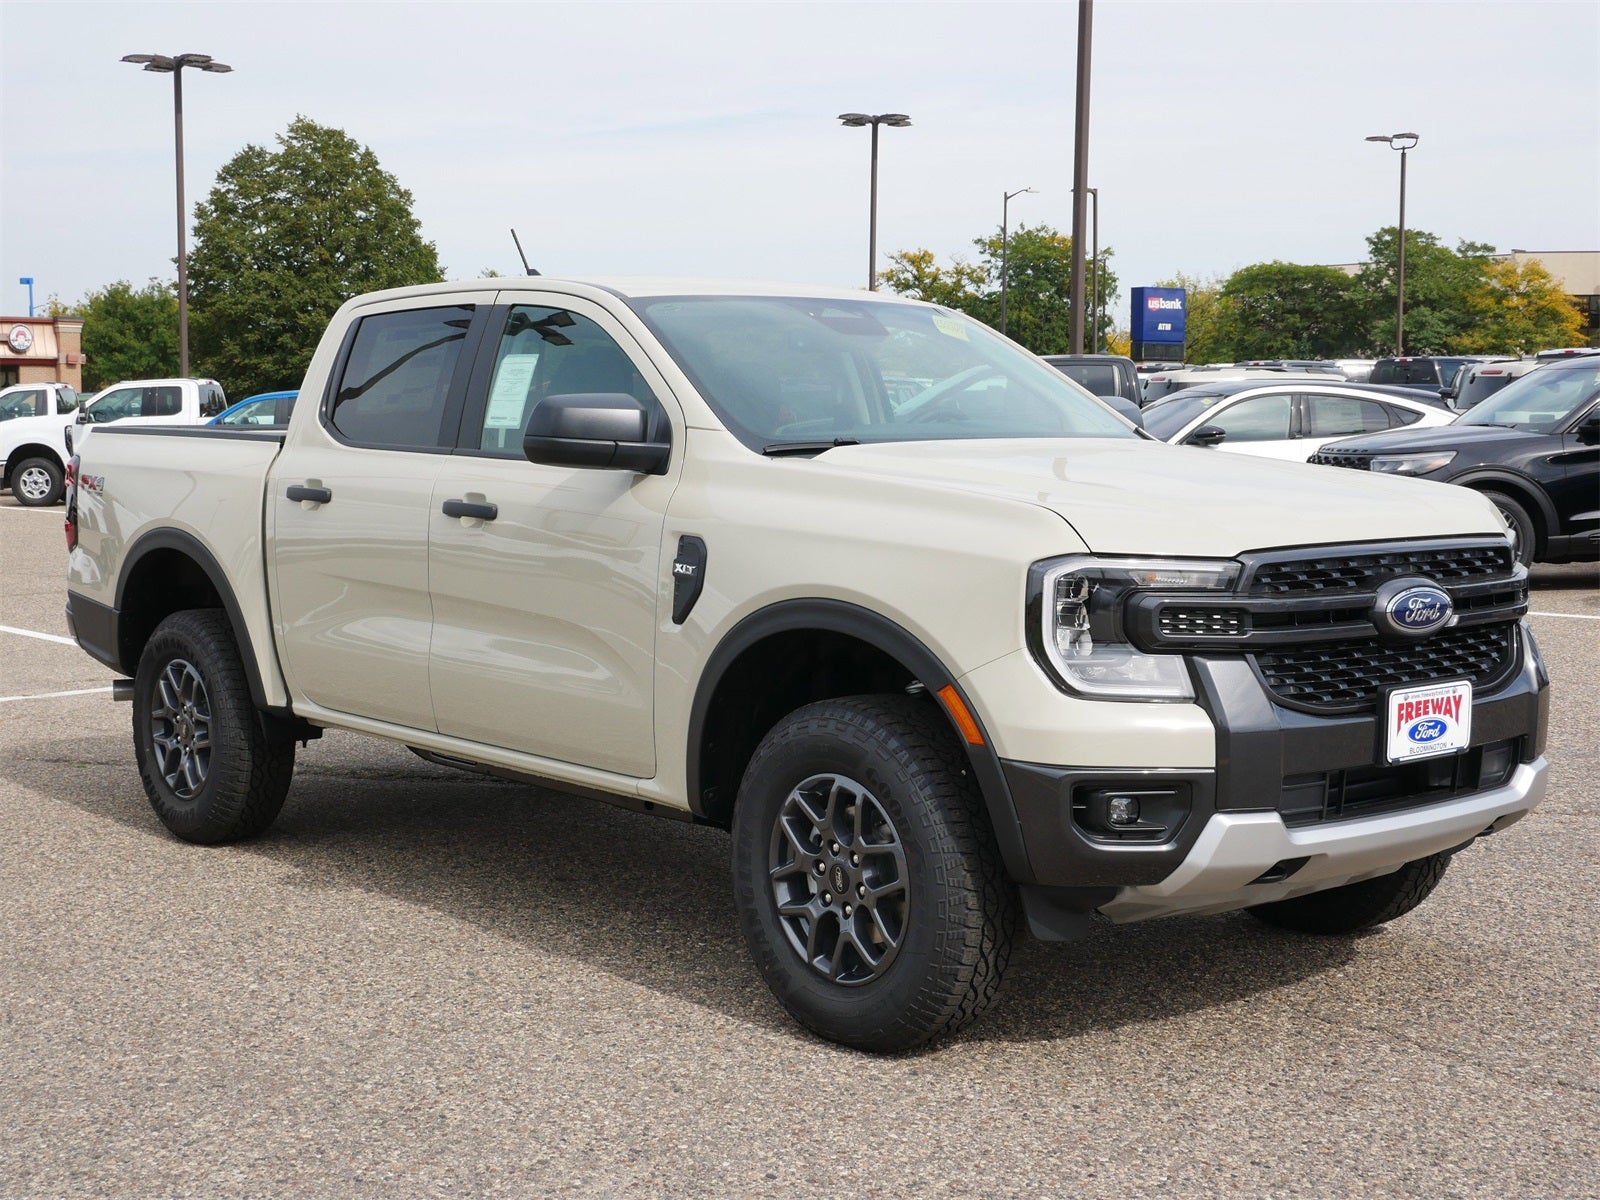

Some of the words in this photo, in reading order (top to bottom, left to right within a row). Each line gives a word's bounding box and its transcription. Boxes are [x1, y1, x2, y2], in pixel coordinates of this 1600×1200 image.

[674, 563, 696, 574] XLT
[1405, 597, 1441, 623] Ford
[1397, 694, 1462, 736] FREEWAY
[1415, 722, 1440, 739] Ford
[1409, 742, 1447, 754] BLOOMINGTON
